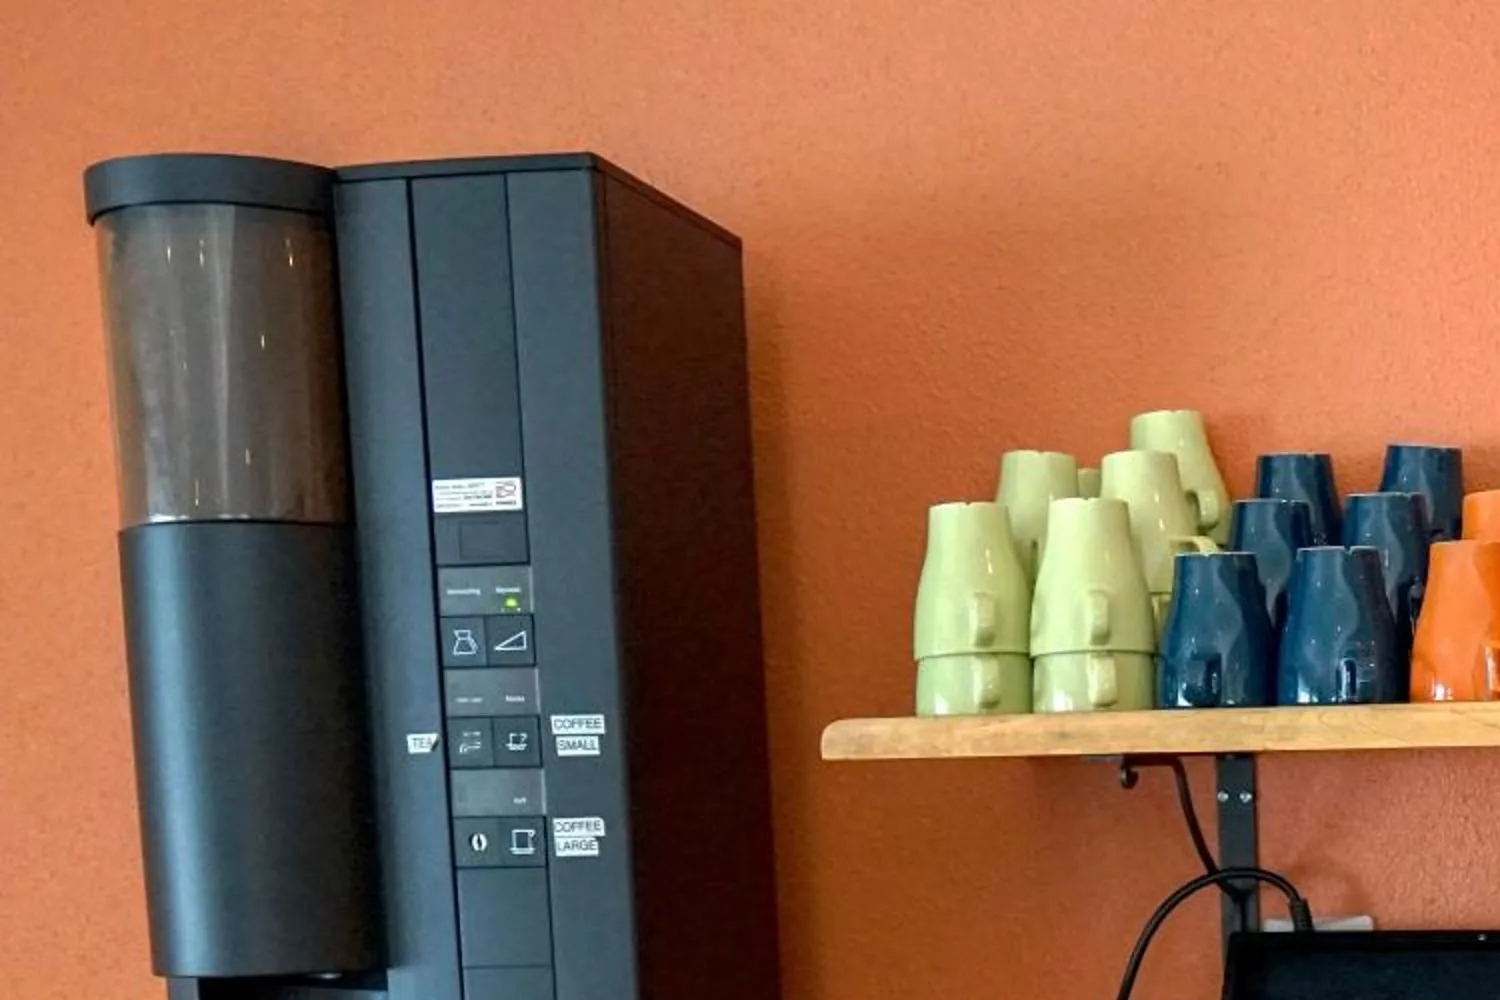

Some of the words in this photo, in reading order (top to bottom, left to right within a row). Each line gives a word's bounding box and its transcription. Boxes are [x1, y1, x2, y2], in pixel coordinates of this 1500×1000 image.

[553, 717, 605, 731] COFFEE
[557, 738, 599, 751] SMALL
[554, 820, 602, 833] COFFEE
[556, 839, 598, 852] LARGE
